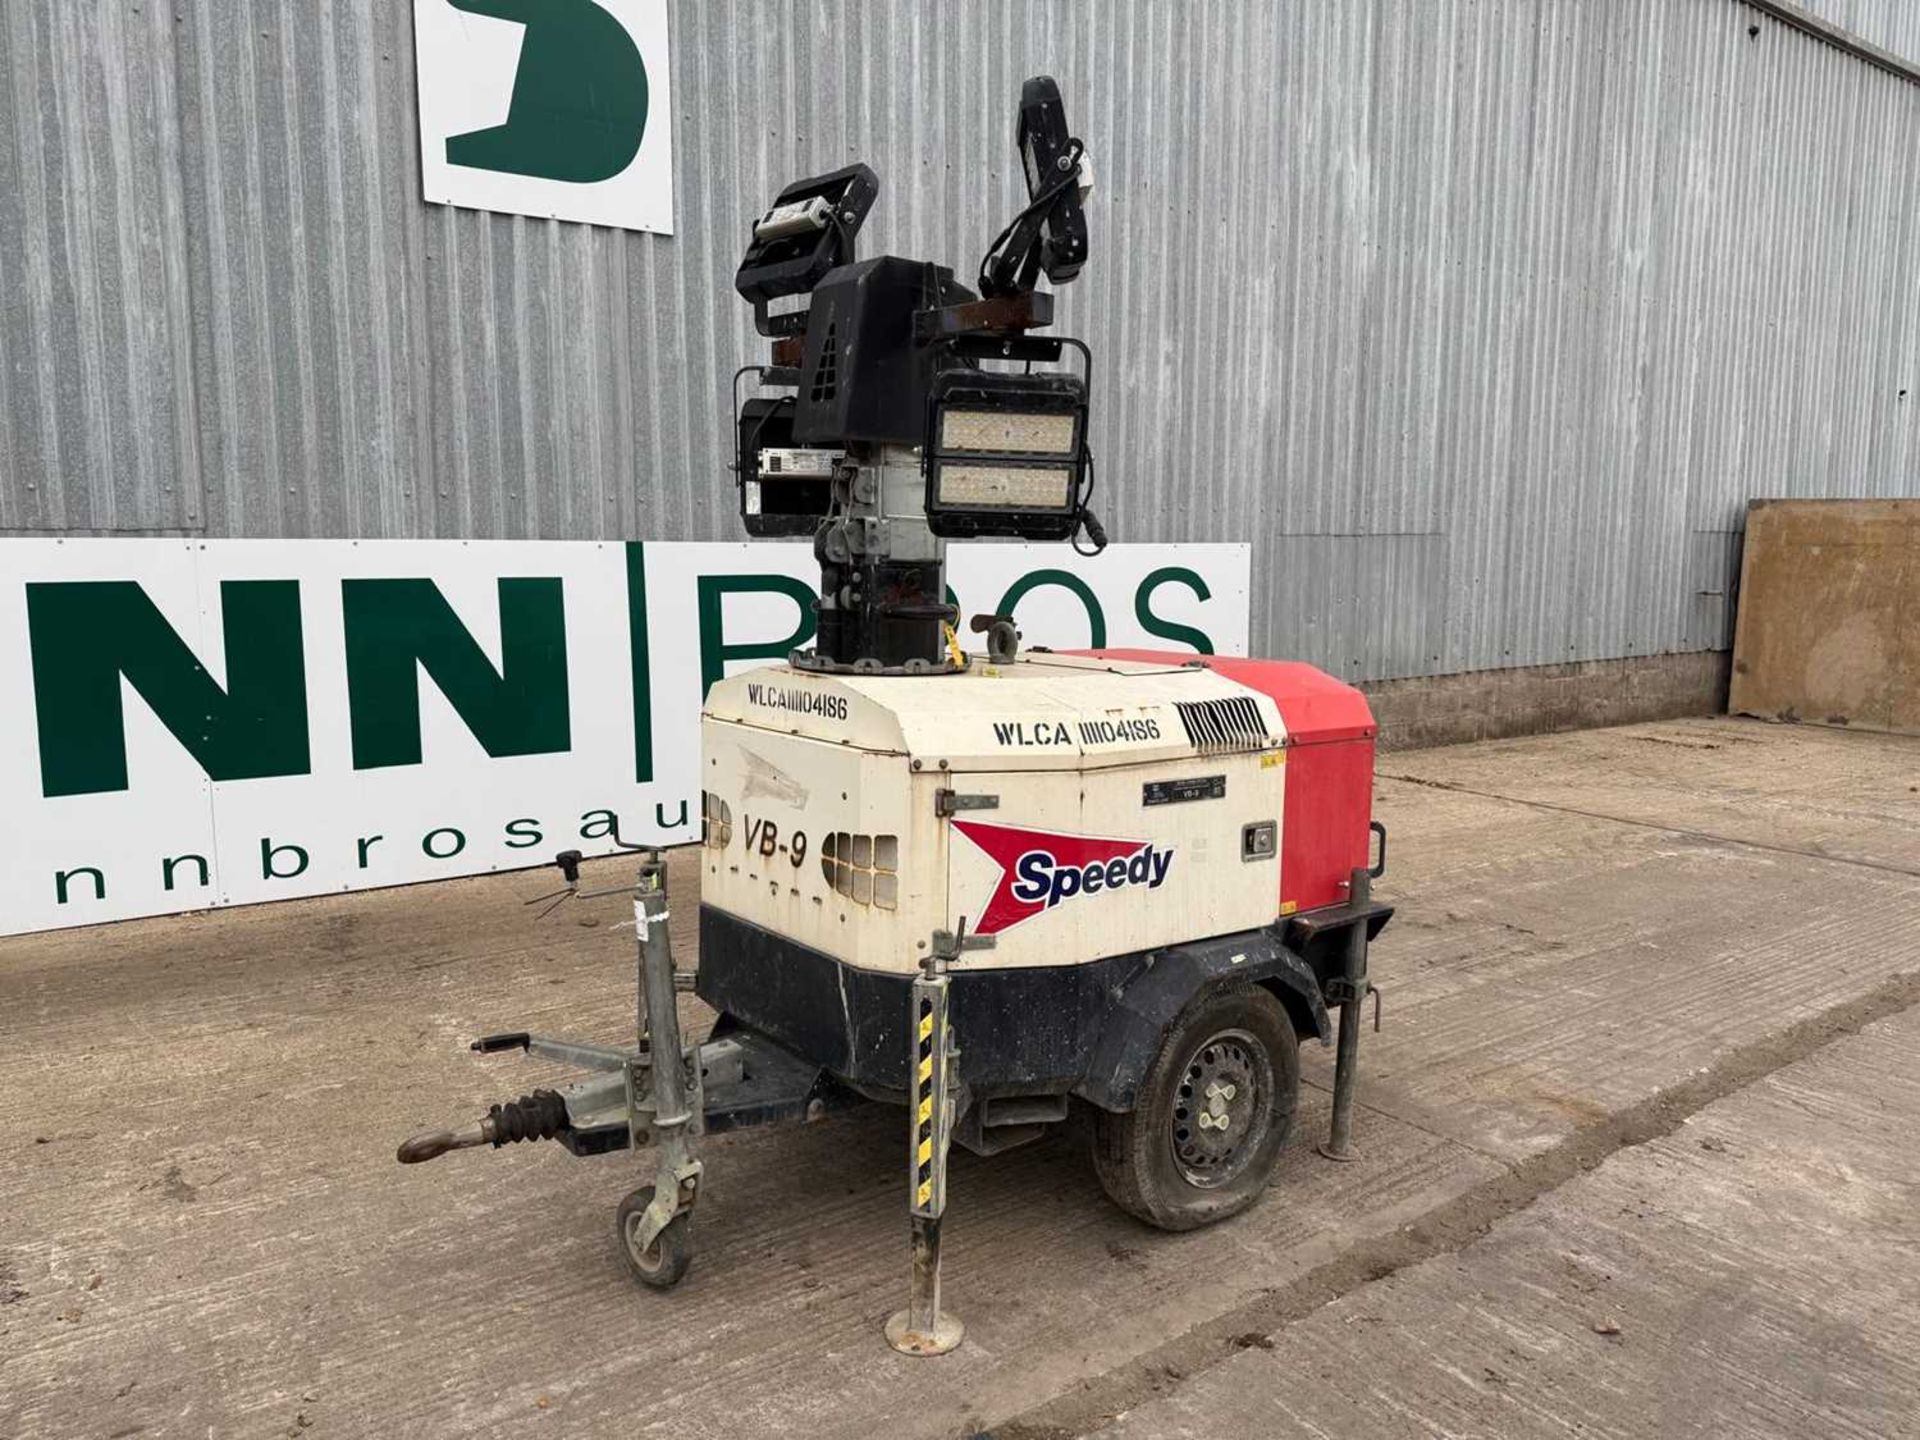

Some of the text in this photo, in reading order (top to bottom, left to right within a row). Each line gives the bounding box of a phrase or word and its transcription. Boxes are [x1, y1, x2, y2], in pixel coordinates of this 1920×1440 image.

[993, 722, 1072, 746] WLCA
[744, 813, 807, 868] VB-9
[1014, 844, 1175, 908] Speedy
